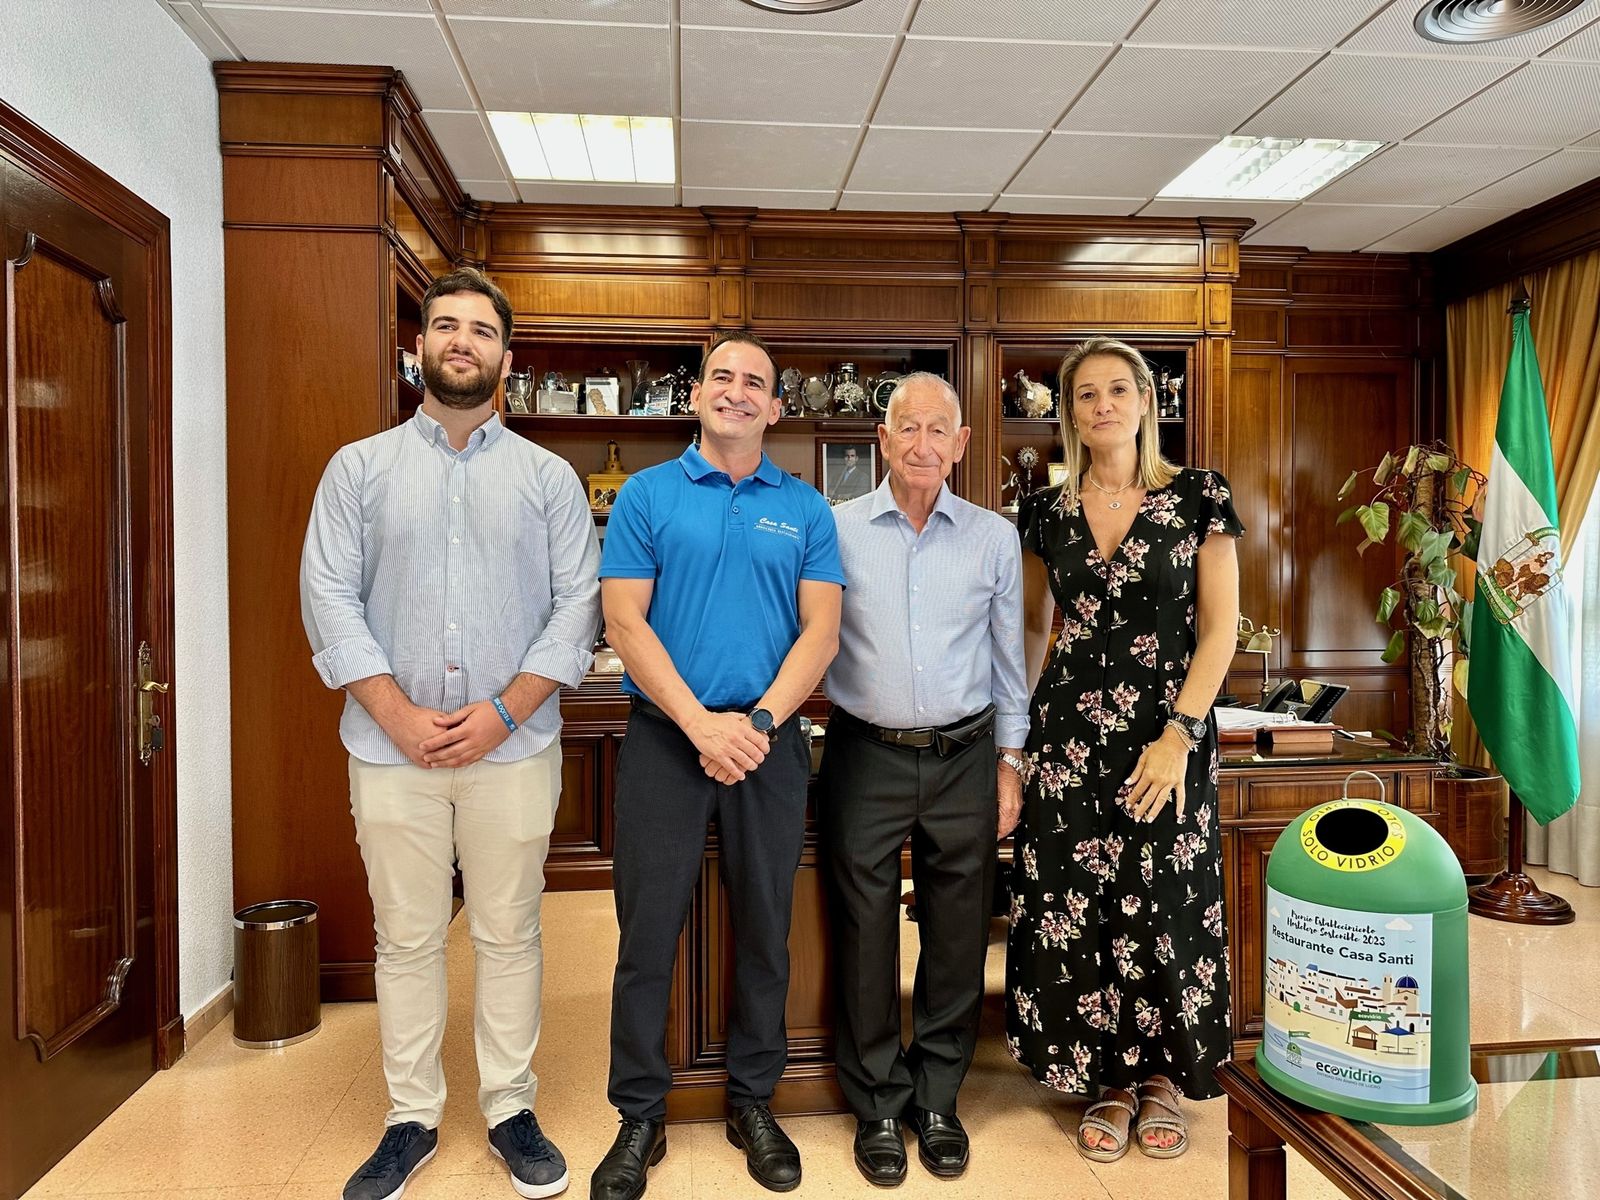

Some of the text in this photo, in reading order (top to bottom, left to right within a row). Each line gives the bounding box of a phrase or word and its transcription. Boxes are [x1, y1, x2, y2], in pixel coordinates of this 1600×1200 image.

[759, 517, 778, 527] Casa
[1302, 829, 1395, 869] SOLO VIDRIO
[1287, 917, 1386, 947] Hostelero Sostenible 2023
[1291, 909, 1376, 934] Premio Establecimiento
[1272, 924, 1414, 965] Restaurante Casa Santi
[1315, 1061, 1383, 1085] ecovidrio
